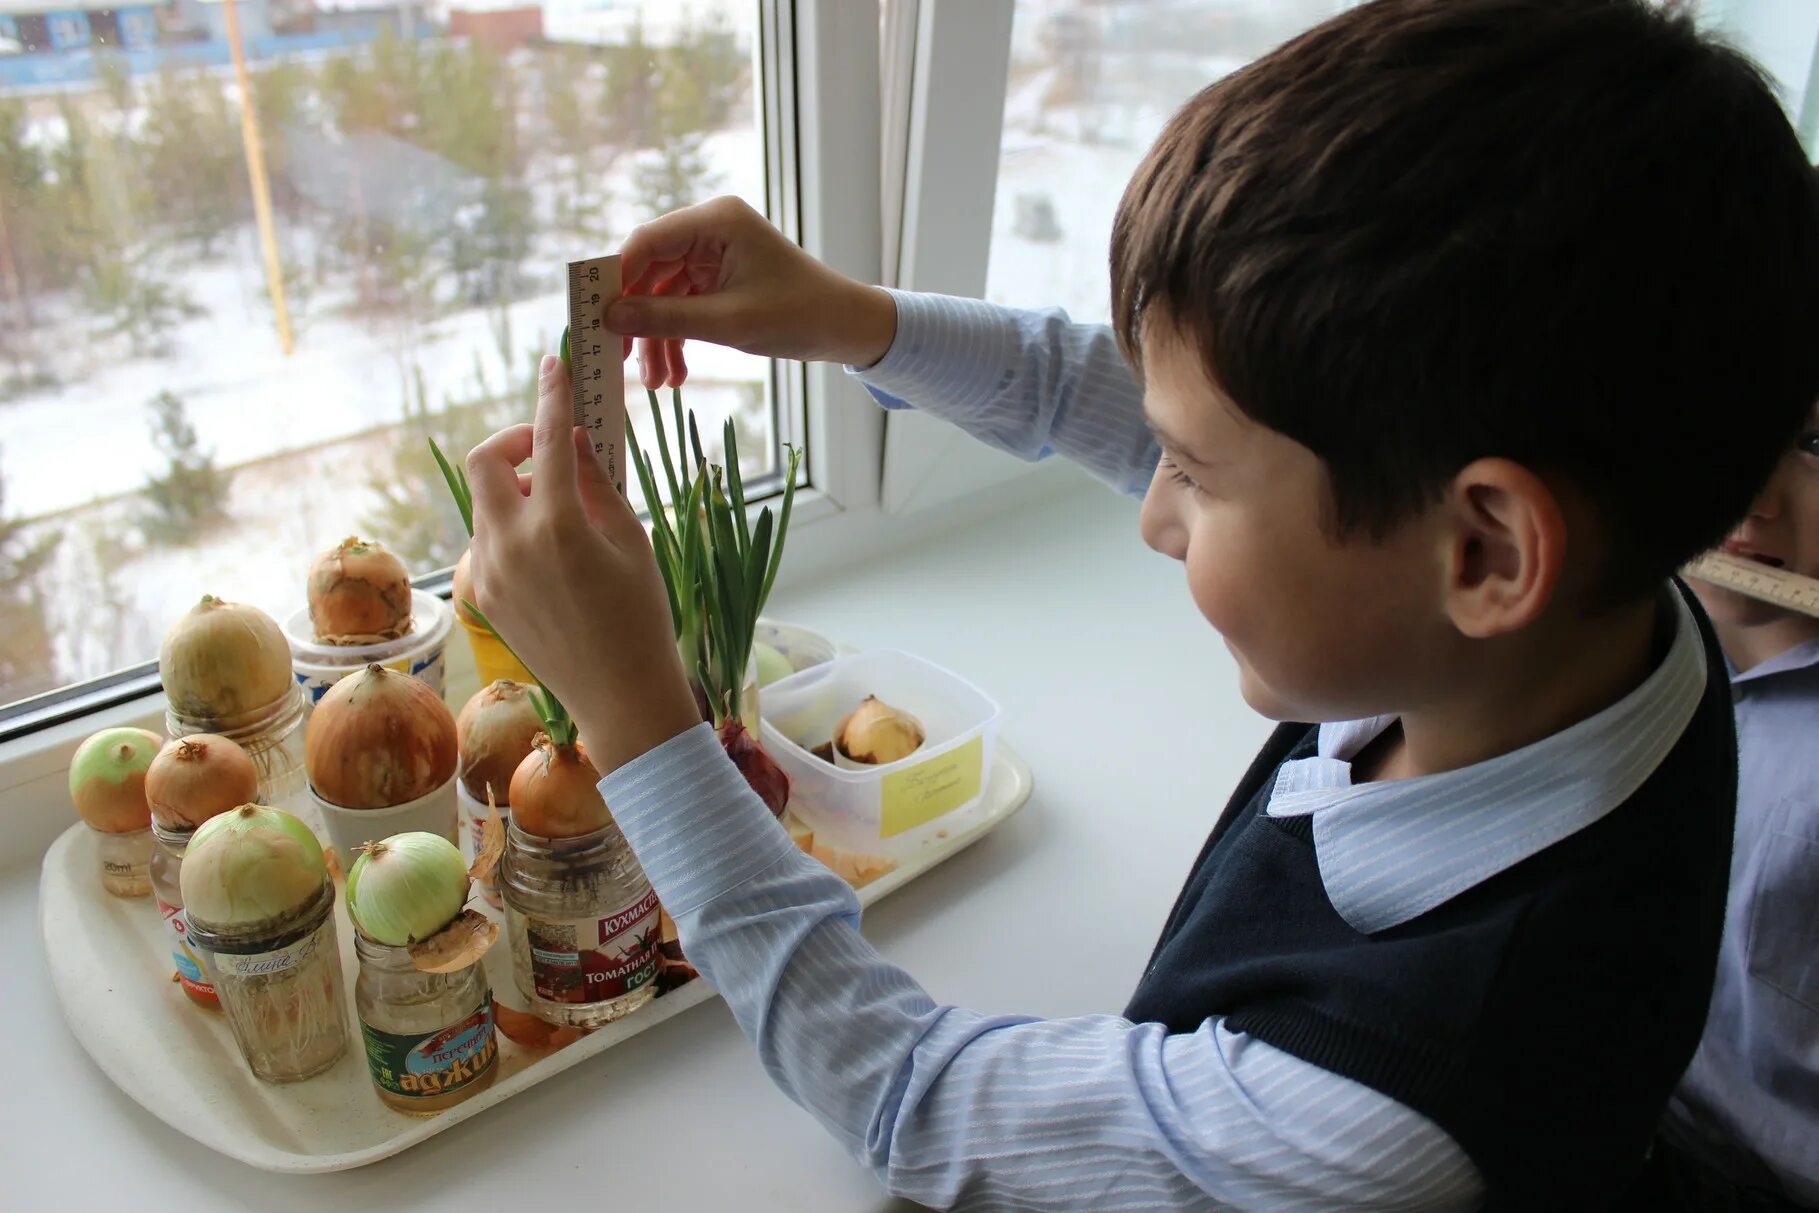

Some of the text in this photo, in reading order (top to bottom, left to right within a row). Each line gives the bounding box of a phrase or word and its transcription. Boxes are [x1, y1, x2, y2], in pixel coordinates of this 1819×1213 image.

[589, 266, 603, 453] 13 14 15 16 17 18 19 20
[604, 890, 659, 936] КУХМАСТЕ
[585, 951, 652, 984] ТОМАТНАЯ
[626, 958, 658, 990] ГОСТ
